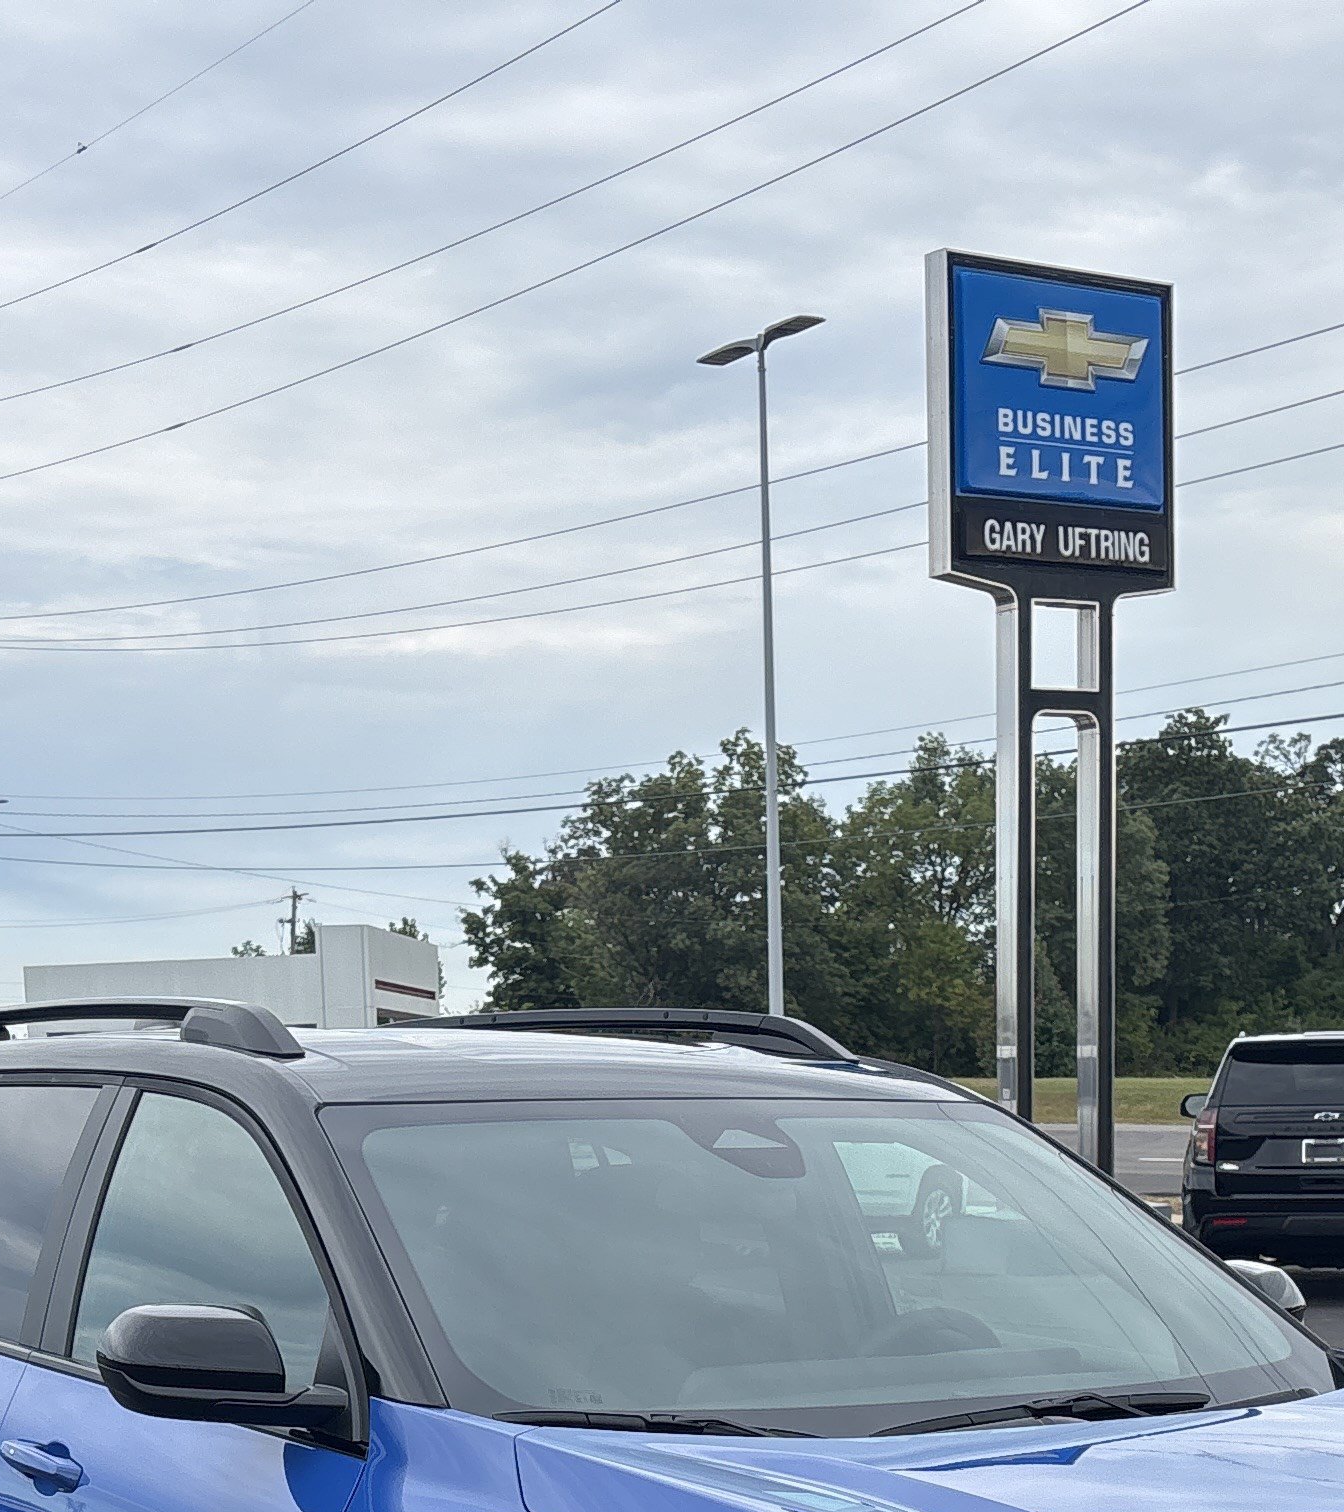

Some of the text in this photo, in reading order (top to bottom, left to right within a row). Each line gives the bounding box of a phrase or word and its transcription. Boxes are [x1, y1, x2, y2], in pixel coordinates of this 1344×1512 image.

[997, 407, 1134, 446] BUSINESS
[998, 446, 1134, 488] ELITE
[984, 519, 1150, 562] GARY UFTRING
